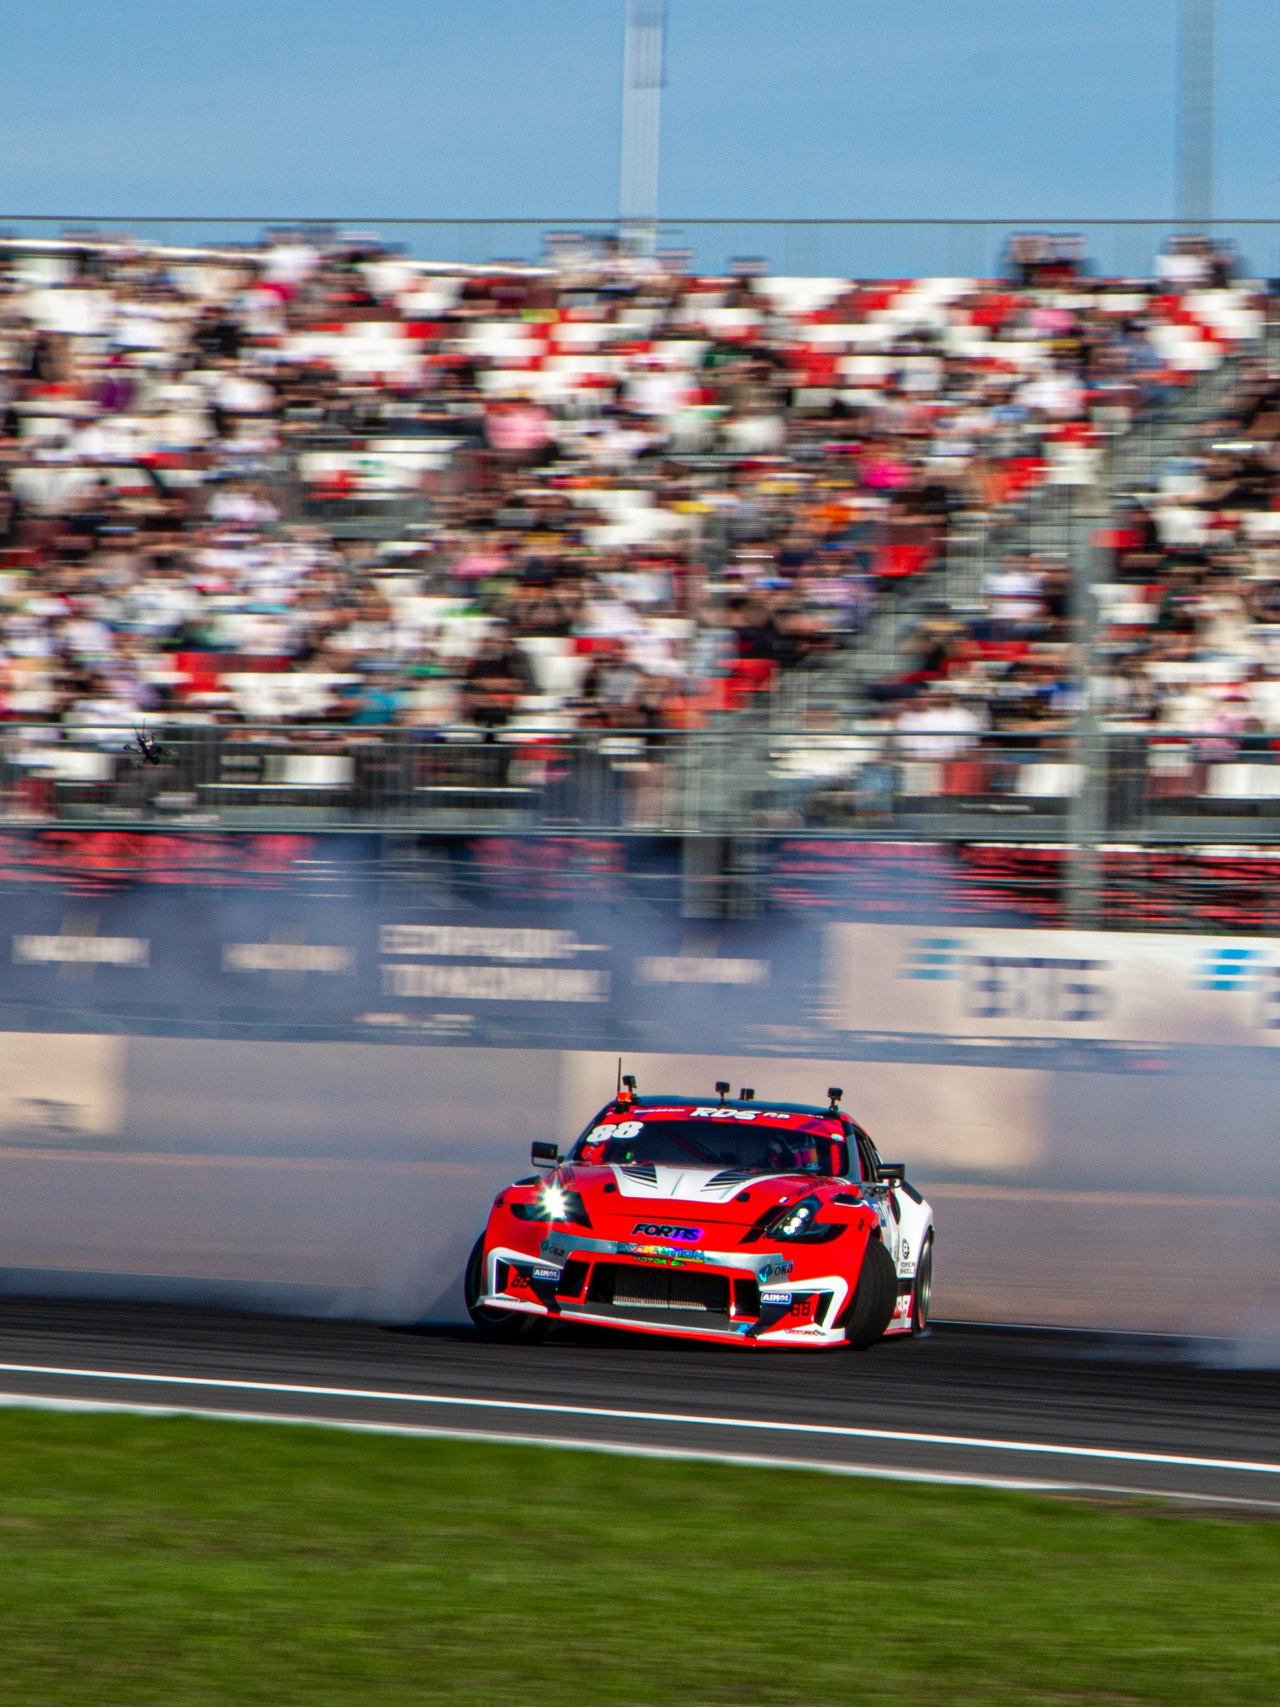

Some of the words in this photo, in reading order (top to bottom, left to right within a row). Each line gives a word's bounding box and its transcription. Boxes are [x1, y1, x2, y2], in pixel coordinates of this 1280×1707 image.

[689, 1107, 762, 1120] RDS
[586, 1121, 644, 1143] 88
[631, 1222, 702, 1241] FORTIS
[633, 1255, 667, 1265] MOTOR
[791, 1301, 811, 1316] 88
